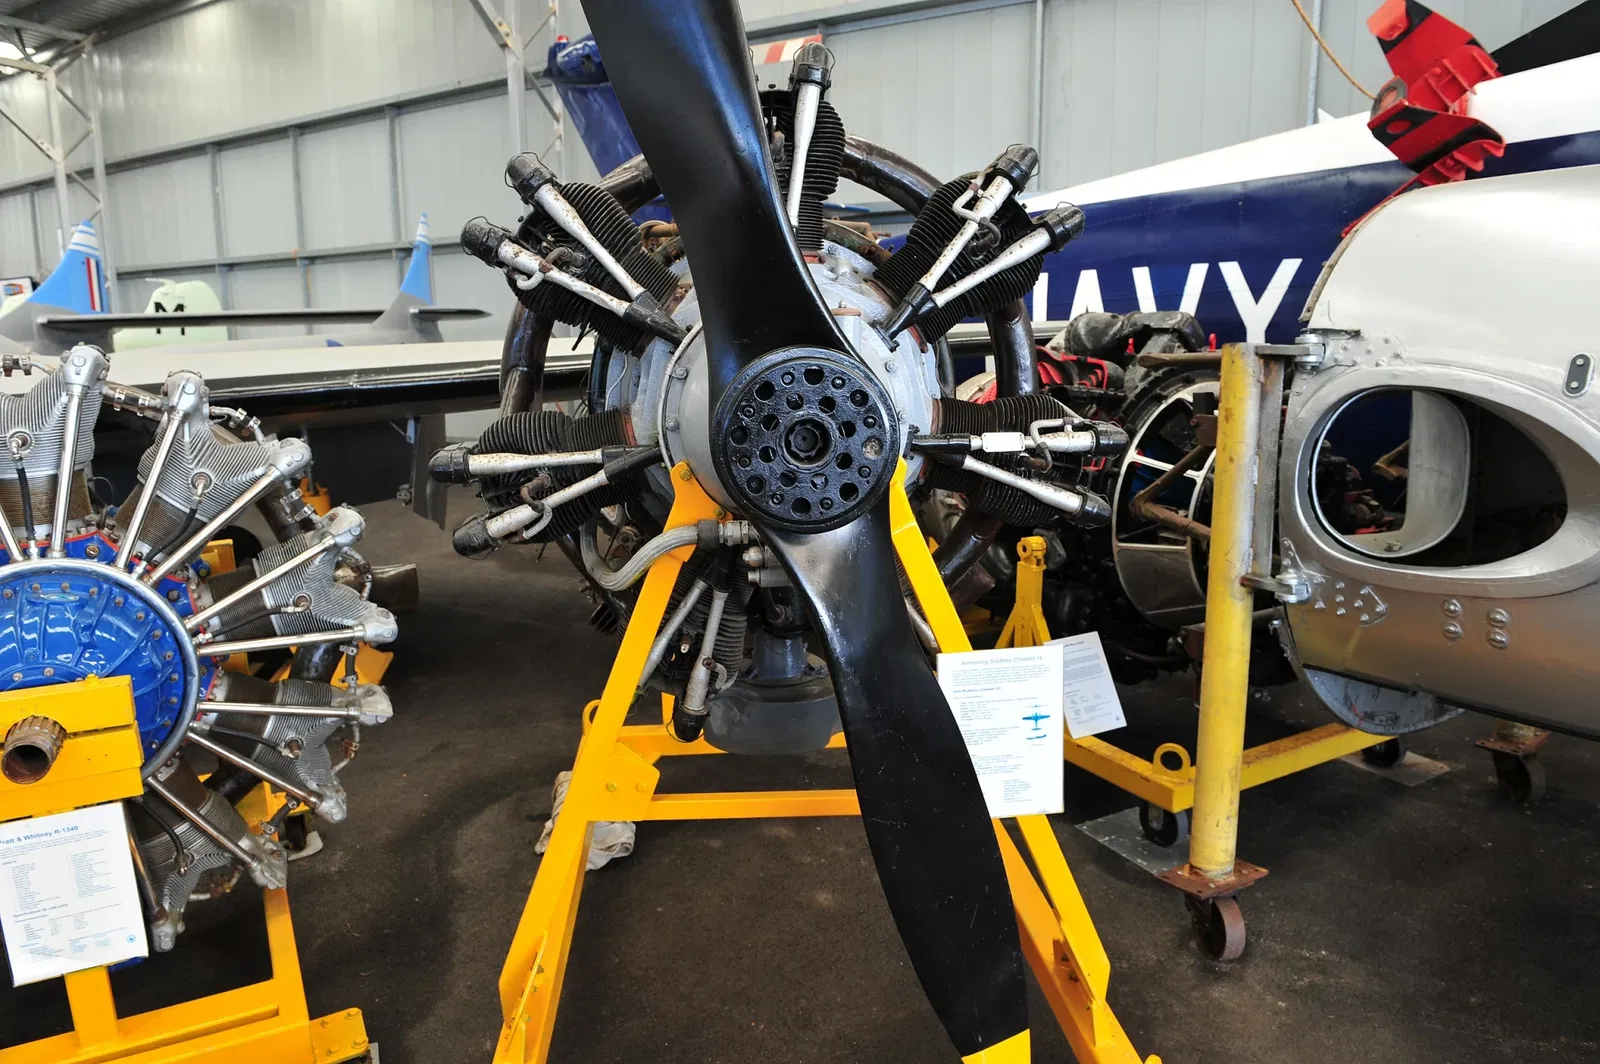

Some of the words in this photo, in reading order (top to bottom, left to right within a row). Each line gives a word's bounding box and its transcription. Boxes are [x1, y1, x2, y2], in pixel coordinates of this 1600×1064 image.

[154, 302, 185, 336] M
[23, 831, 52, 841] Whitney
[54, 825, 79, 835] R-1340
